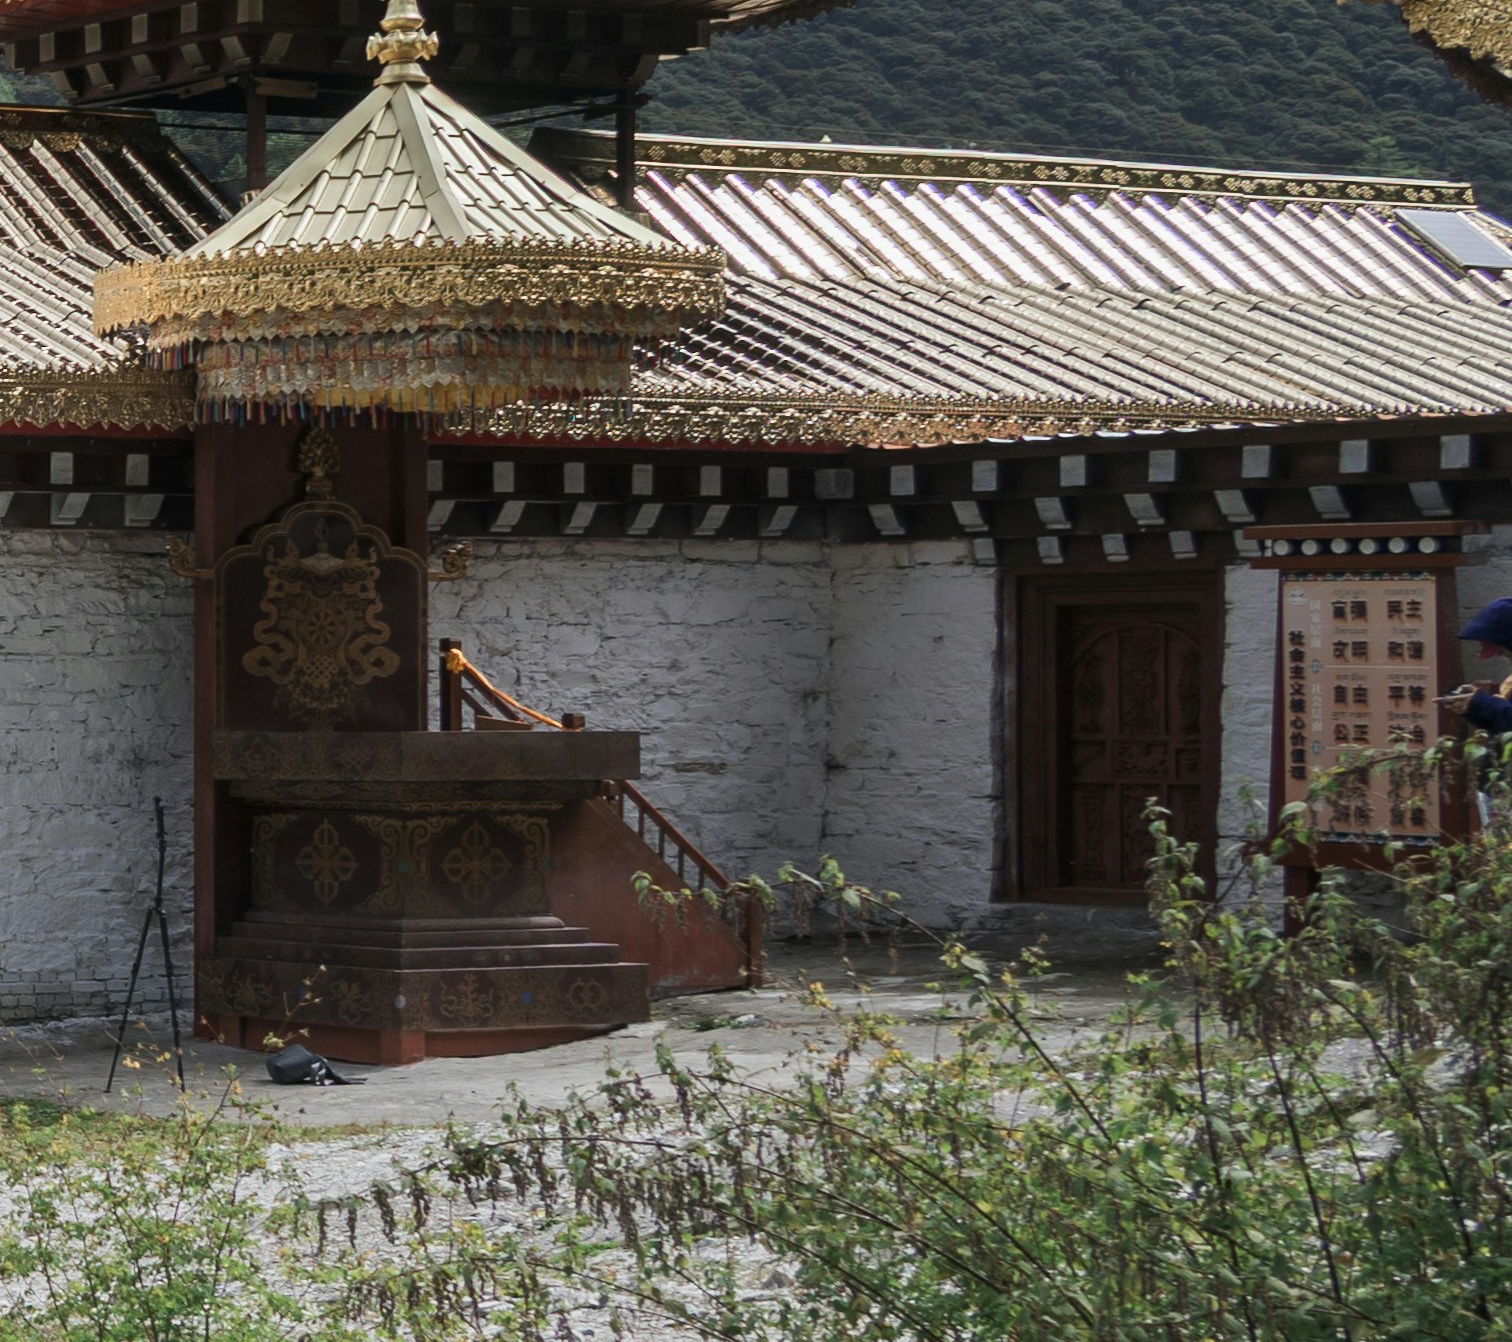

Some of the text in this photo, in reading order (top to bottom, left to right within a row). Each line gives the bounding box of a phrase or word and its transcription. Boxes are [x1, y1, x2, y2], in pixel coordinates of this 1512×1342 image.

[1331, 599, 1422, 619] 富强 民主
[1332, 640, 1423, 659] 文明 和谐
[1334, 684, 1425, 705] 自由 平等
[1334, 723, 1368, 741] 公正
